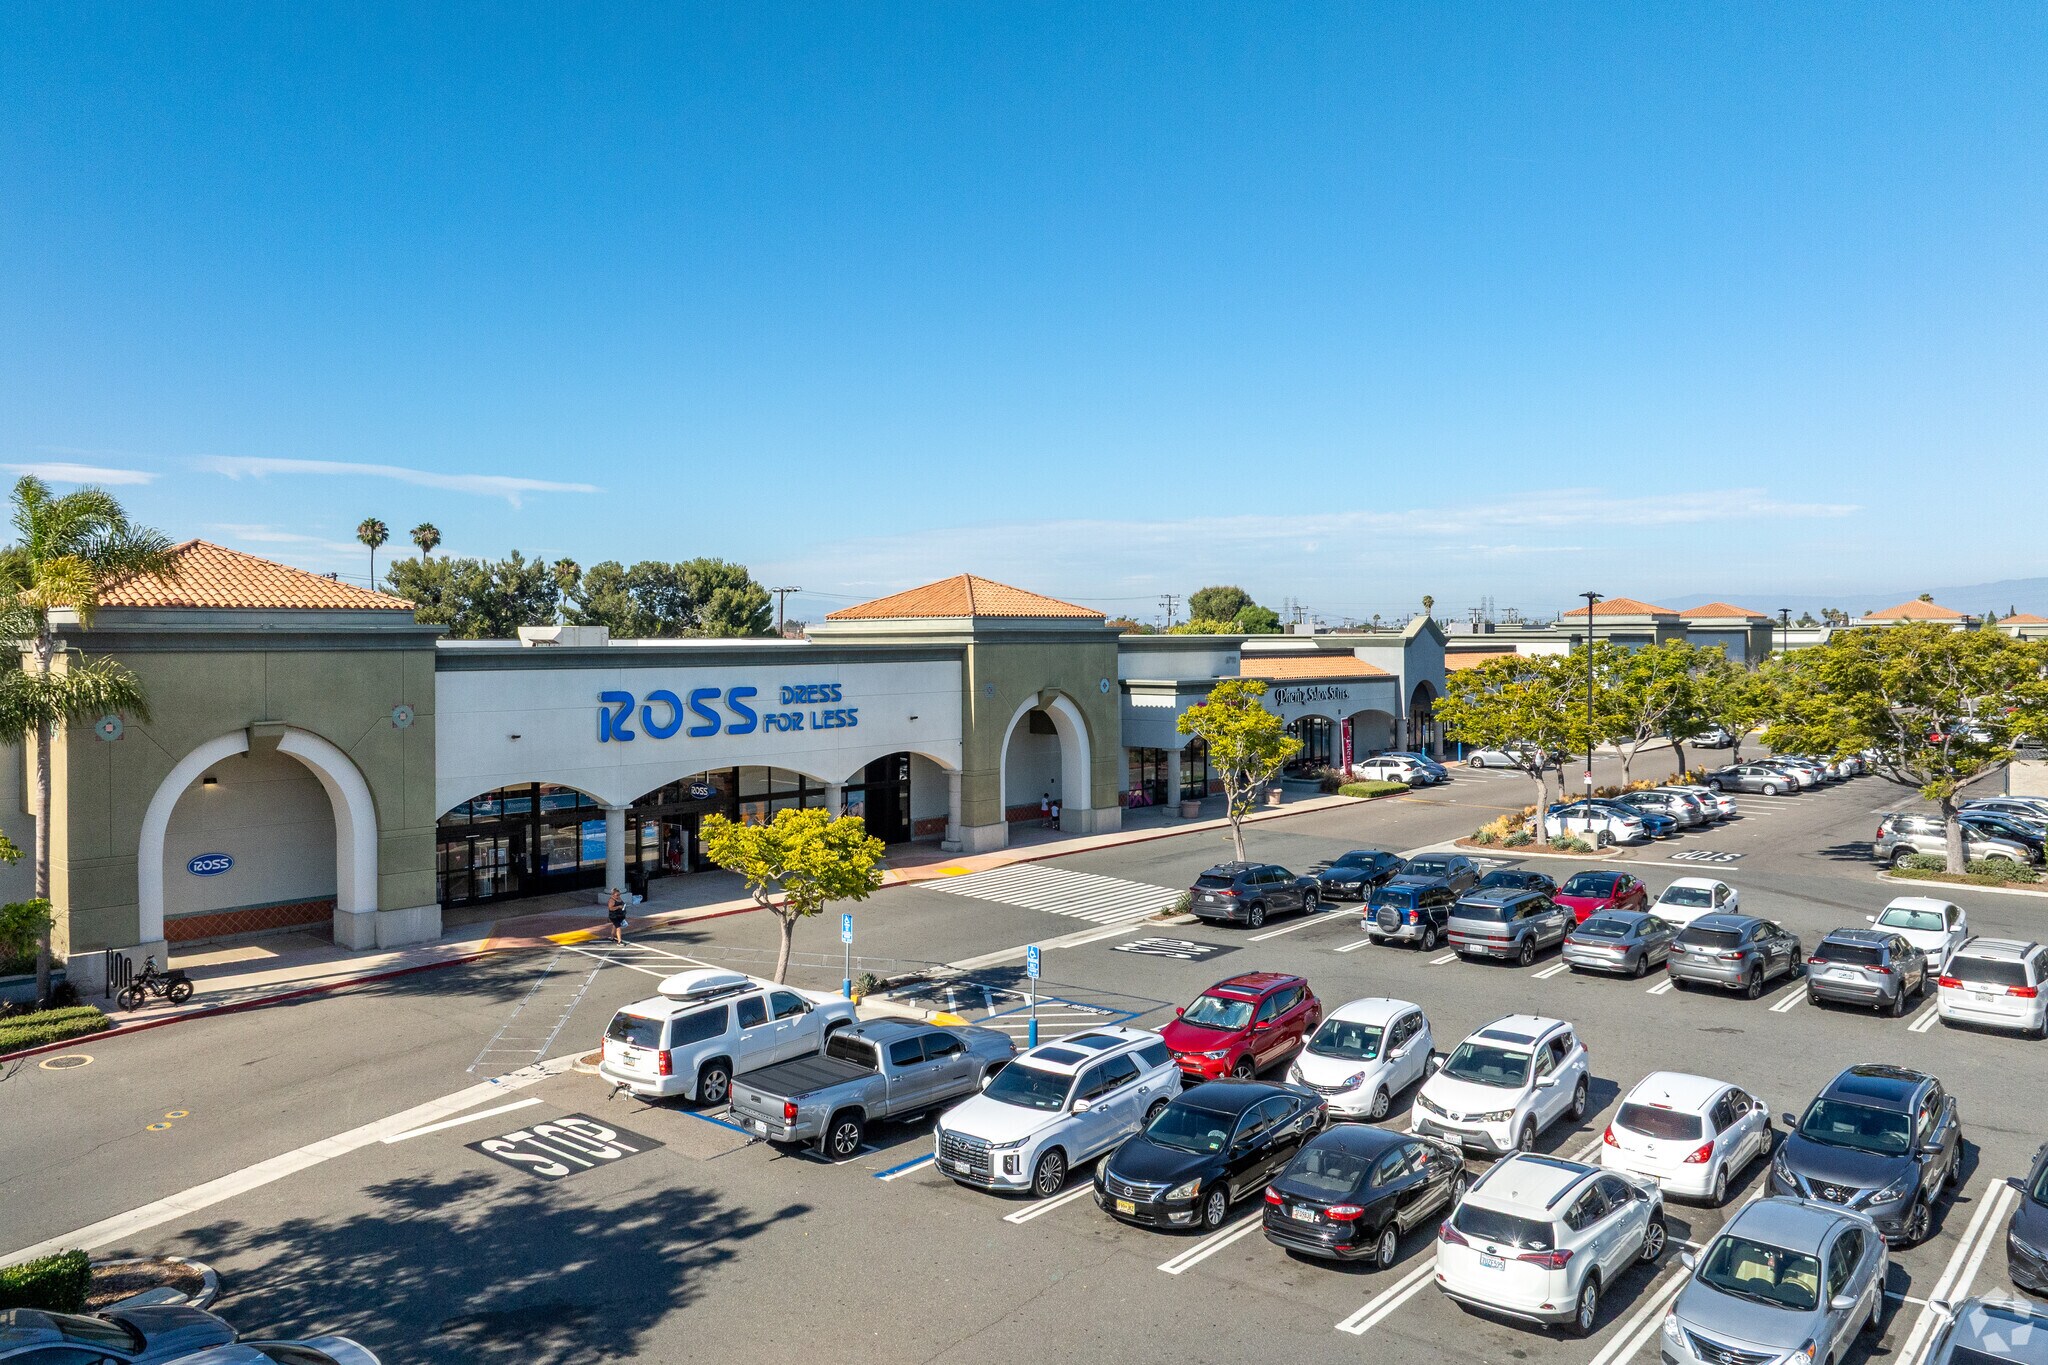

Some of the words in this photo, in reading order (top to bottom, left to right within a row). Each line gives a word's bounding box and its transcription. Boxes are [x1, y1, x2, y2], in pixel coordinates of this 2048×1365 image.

[780, 683, 842, 705] DRESS
[597, 686, 758, 743] ROSS
[763, 711, 804, 733] FOR
[810, 708, 858, 730] LESS
[691, 786, 708, 796] ROSS
[193, 858, 229, 871] ROSS
[1671, 850, 1742, 862] STOP
[481, 1118, 639, 1176] STOP
